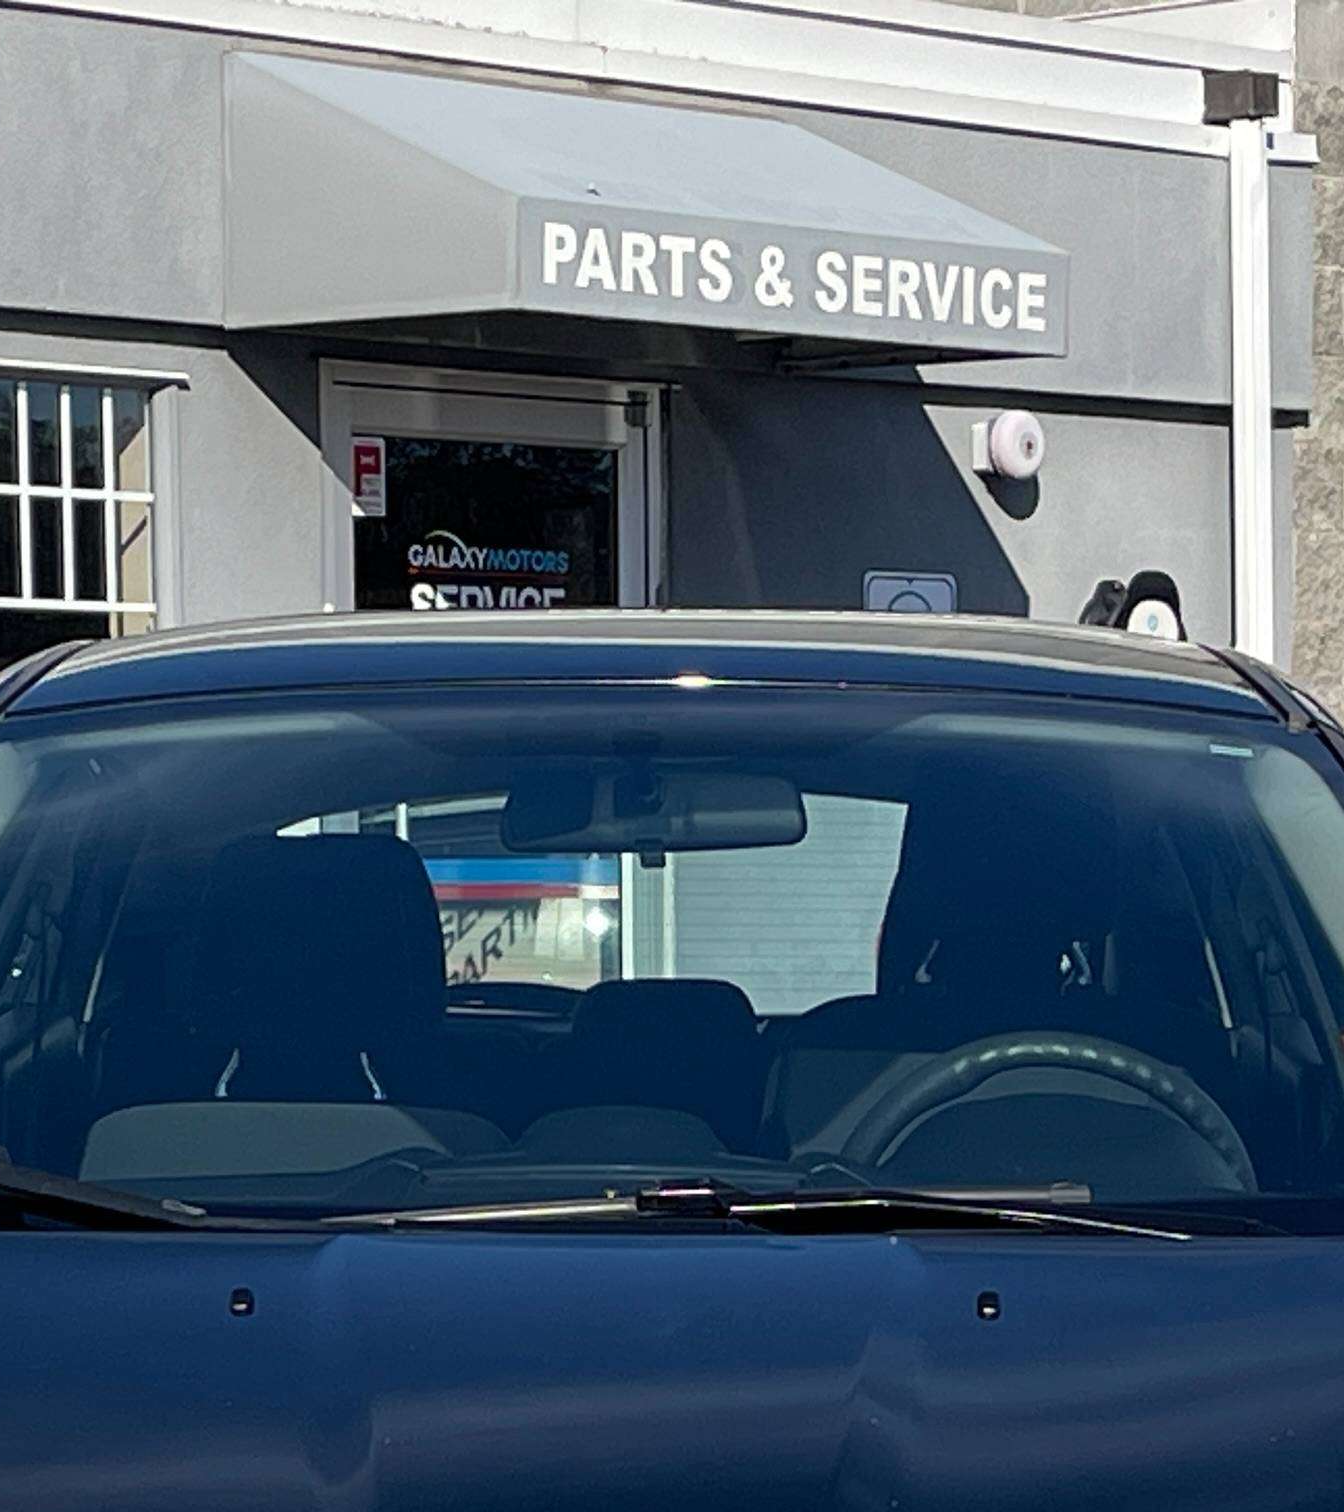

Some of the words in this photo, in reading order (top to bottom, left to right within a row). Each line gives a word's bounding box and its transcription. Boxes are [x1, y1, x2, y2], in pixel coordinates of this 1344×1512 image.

[542, 221, 734, 302] PARTS
[754, 245, 794, 309] &
[815, 251, 1048, 332] SERVICE
[407, 543, 570, 574] GALAXYMOTORS
